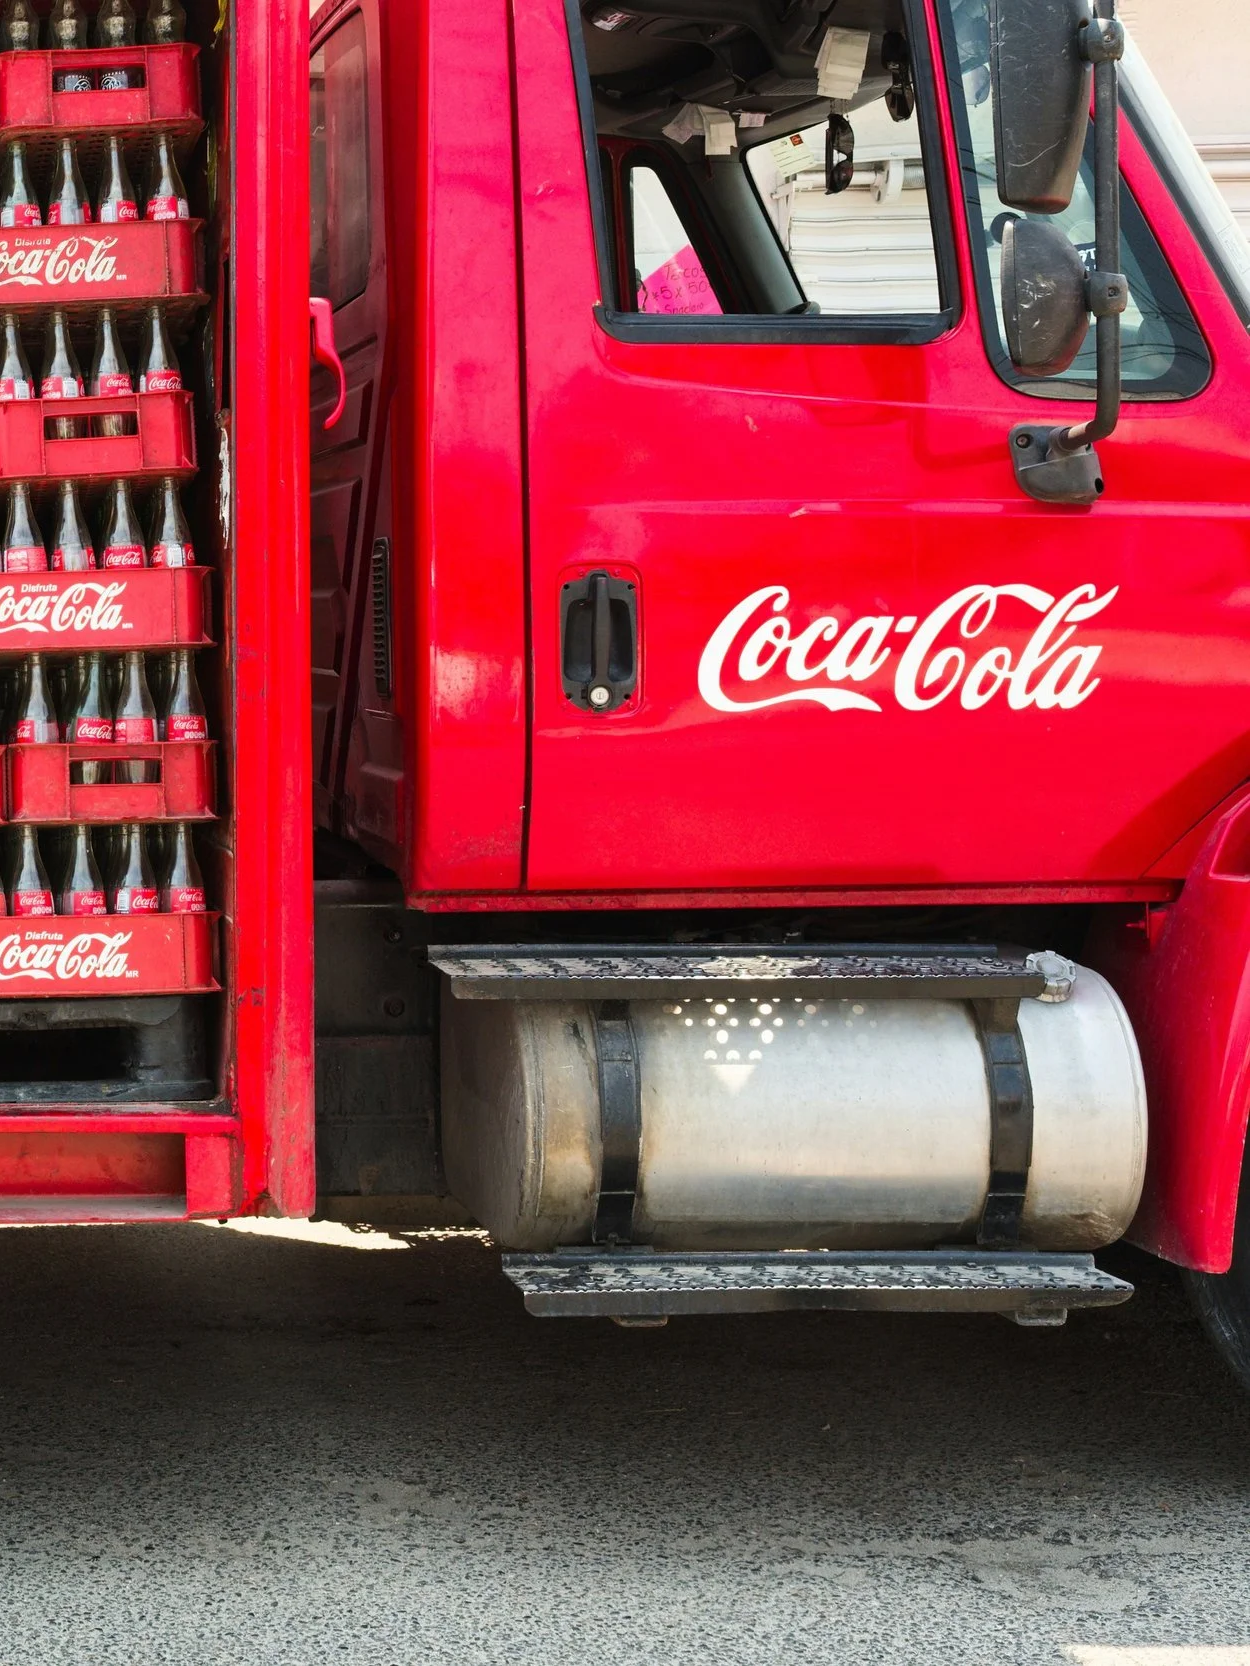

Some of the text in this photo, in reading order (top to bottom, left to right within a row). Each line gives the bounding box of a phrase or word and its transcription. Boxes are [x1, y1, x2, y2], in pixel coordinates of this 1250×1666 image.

[106, 551, 141, 567] Coca-Cola
[21, 583, 57, 593] Disfruta
[697, 582, 1120, 713] Coca-Cola
[25, 930, 64, 941] Disfruta
[125, 970, 139, 979] MR
